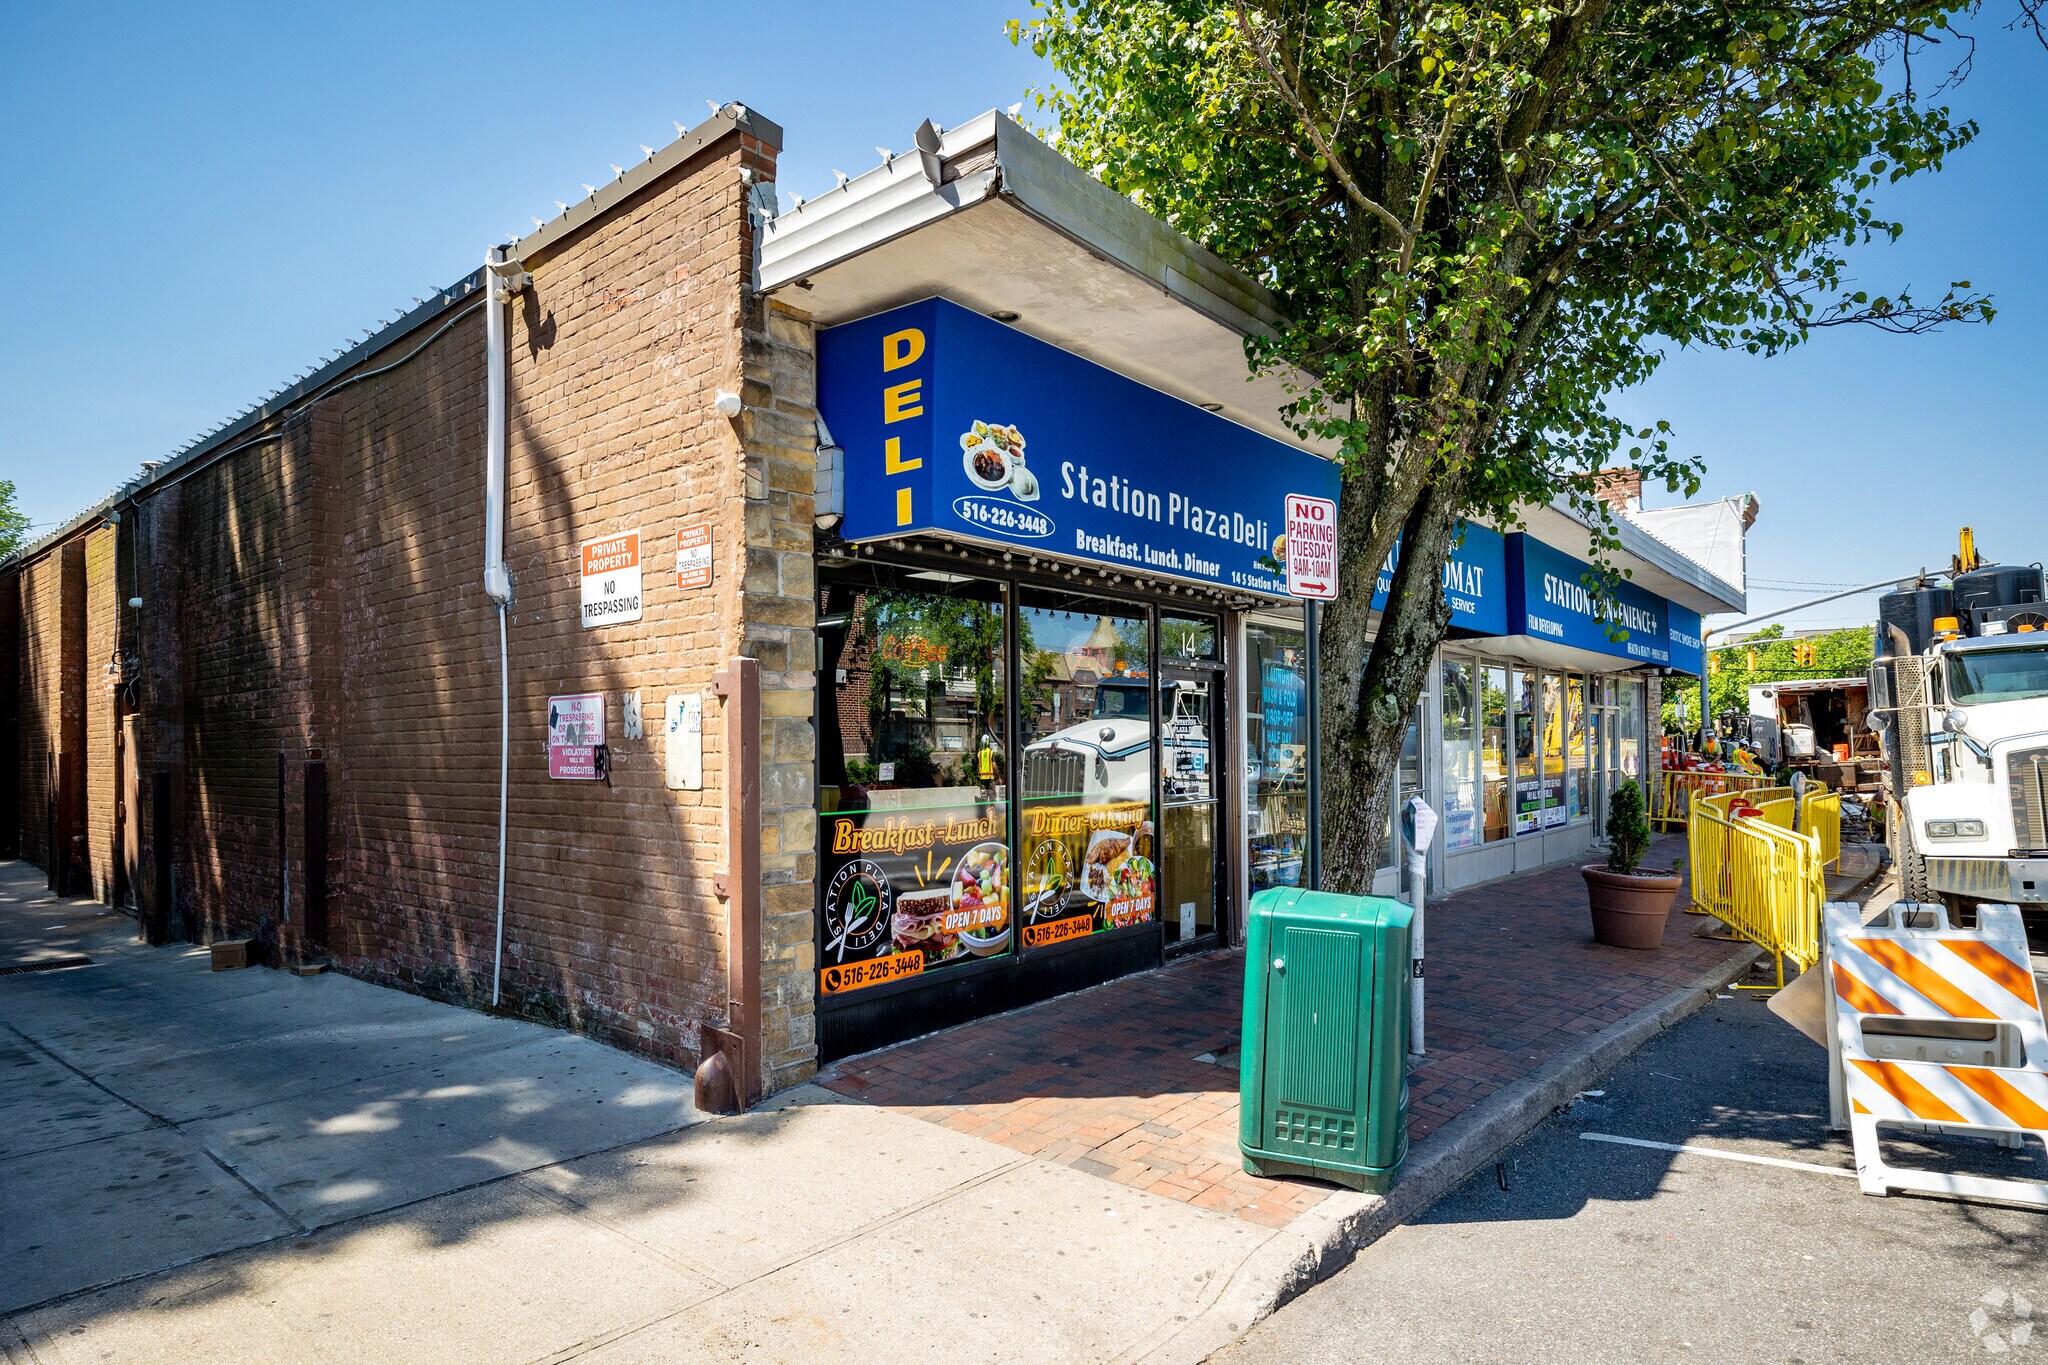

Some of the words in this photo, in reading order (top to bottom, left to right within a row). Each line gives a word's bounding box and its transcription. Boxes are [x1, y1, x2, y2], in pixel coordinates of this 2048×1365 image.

[883, 328, 926, 526] DELI
[1061, 462, 1160, 522] Station
[963, 501, 1048, 535] 516-226-3448
[1295, 502, 1325, 521] NO
[680, 535, 708, 548] PROPERTY
[682, 527, 705, 539] PRIVATE
[1290, 521, 1333, 544] PARKING
[591, 539, 627, 557] PRIVATE
[1291, 540, 1333, 560] TUESDAY
[587, 551, 633, 573] PROPERTY
[1185, 552, 1220, 577] Dinner
[1293, 558, 1331, 579] 9AM-10AM
[604, 580, 615, 595] NO
[1231, 572, 1240, 584] 14
[1241, 574, 1247, 585] S
[1247, 575, 1271, 590] Station
[1544, 573, 1591, 615] STATION
[584, 596, 639, 618] TRESPASSING
[1452, 597, 1475, 613] SERVICE
[1181, 632, 1195, 658] 14
[572, 702, 582, 712] NO
[1284, 690, 1296, 707] FOLD
[559, 713, 594, 722] TRESPASSING
[1266, 709, 1293, 727] DROP-OFF
[552, 735, 559, 743] ON
[559, 725, 566, 733] OR
[562, 748, 592, 756] VIOLATORS
[560, 766, 595, 774] PROSECUTED
[865, 863, 889, 910] PLAZA
[827, 863, 858, 935] STATION
[1112, 901, 1129, 917] OPEN
[1131, 900, 1135, 911] 7
[1136, 897, 1151, 912] DAYS
[945, 910, 970, 930] OPEN
[973, 908, 979, 923] 7
[979, 905, 1002, 922] DAYS
[854, 921, 884, 948] DELI
[1036, 918, 1092, 942] 516-226-3448
[843, 954, 920, 986] 516-226-3448
